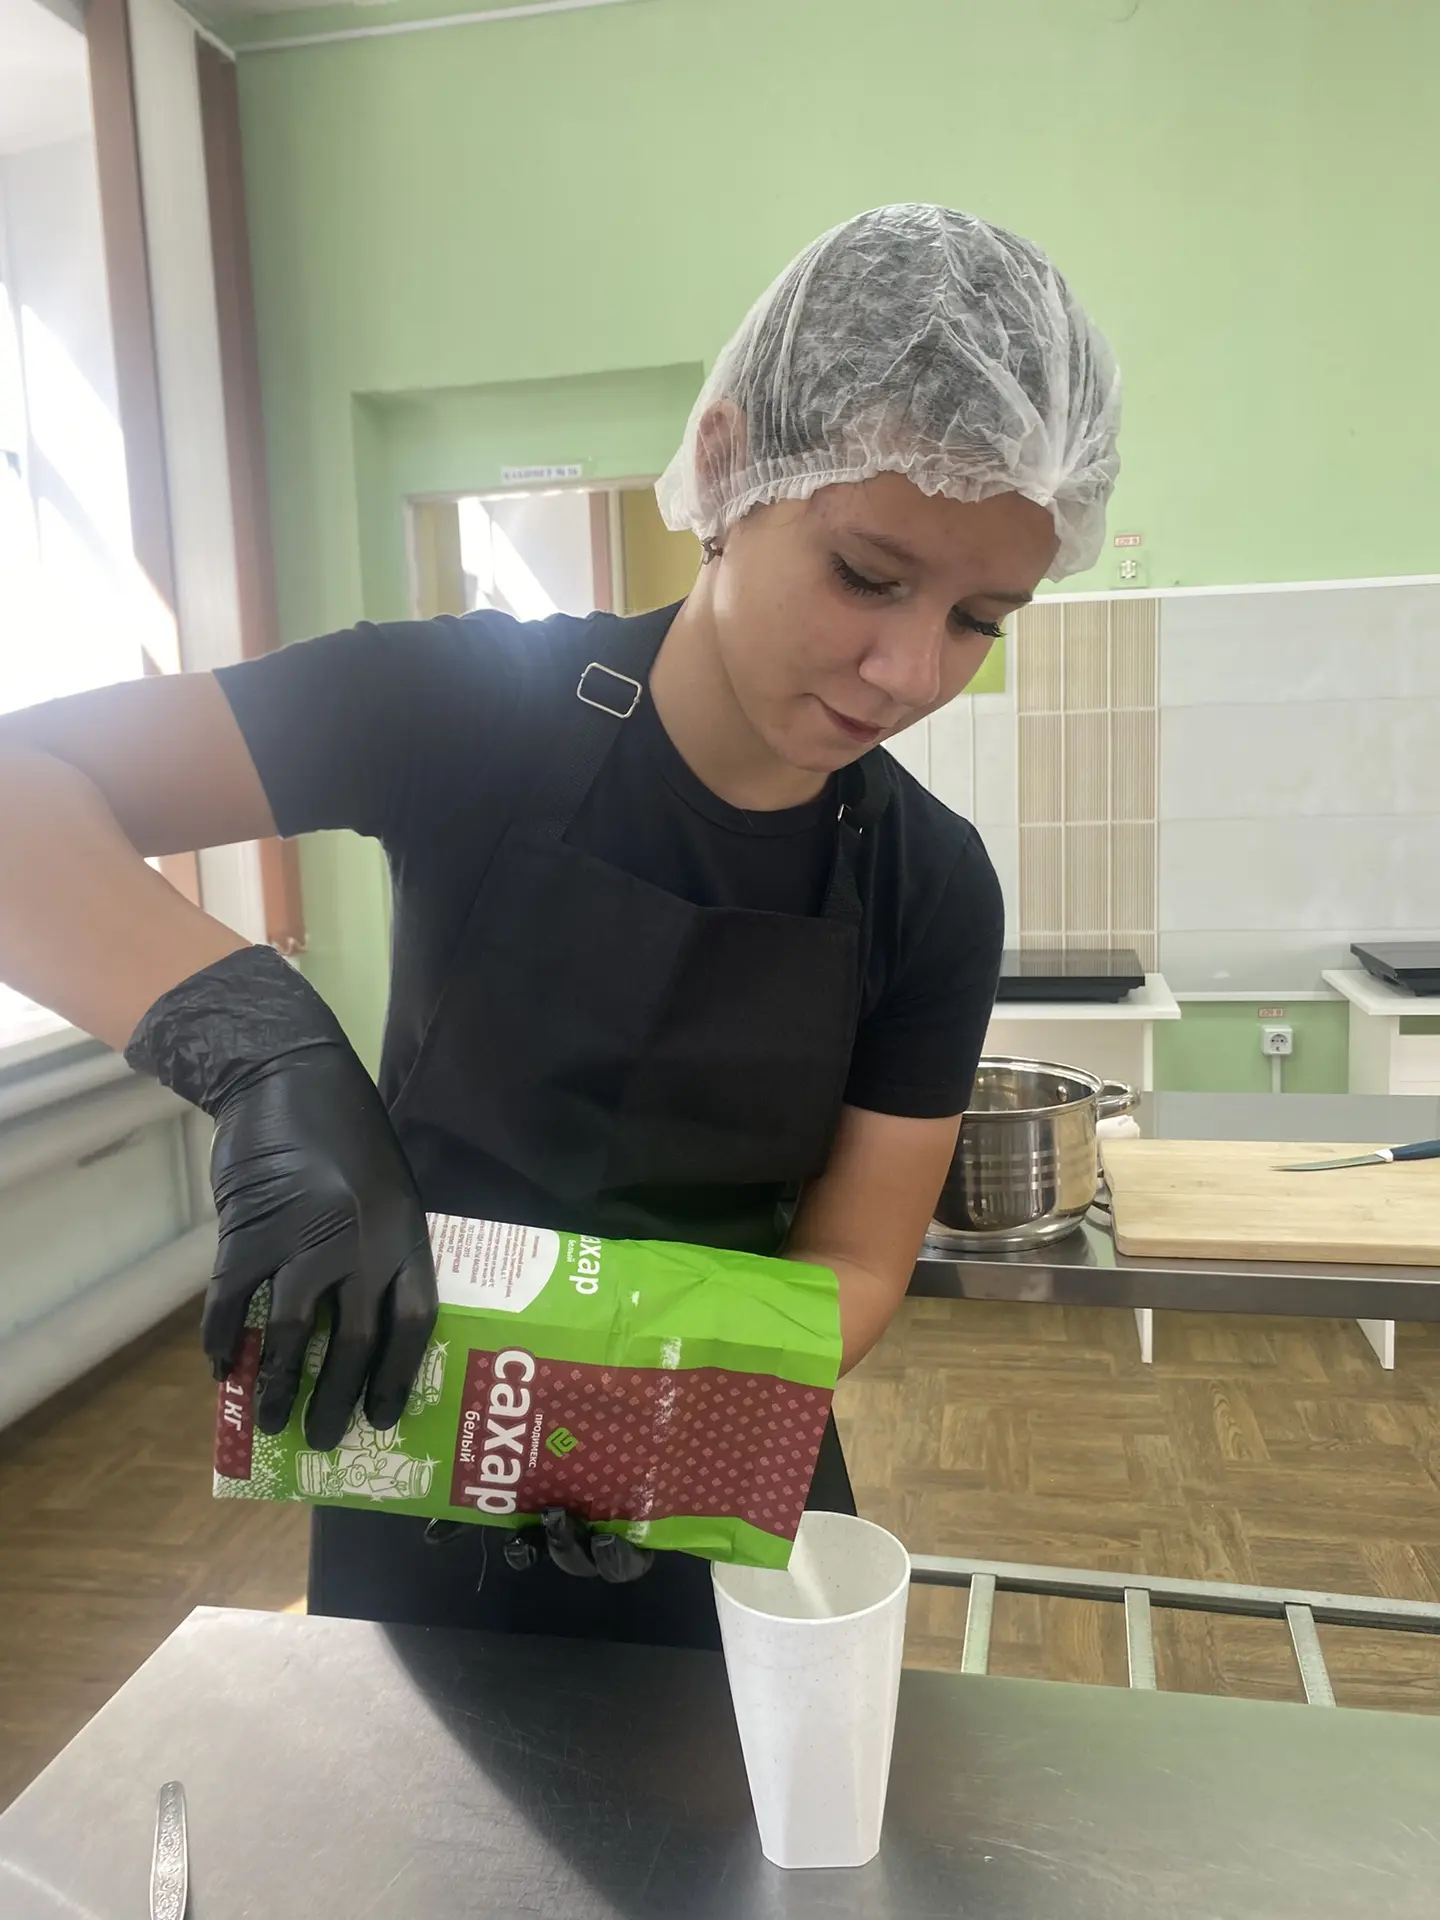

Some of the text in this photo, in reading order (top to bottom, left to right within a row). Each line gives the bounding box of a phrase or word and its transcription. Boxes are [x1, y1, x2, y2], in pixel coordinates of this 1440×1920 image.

[226, 1381, 244, 1393] 1
[459, 1410, 480, 1463] белый
[464, 1350, 535, 1515] сахар
[529, 1414, 543, 1468] ПРОДИМЕКС
